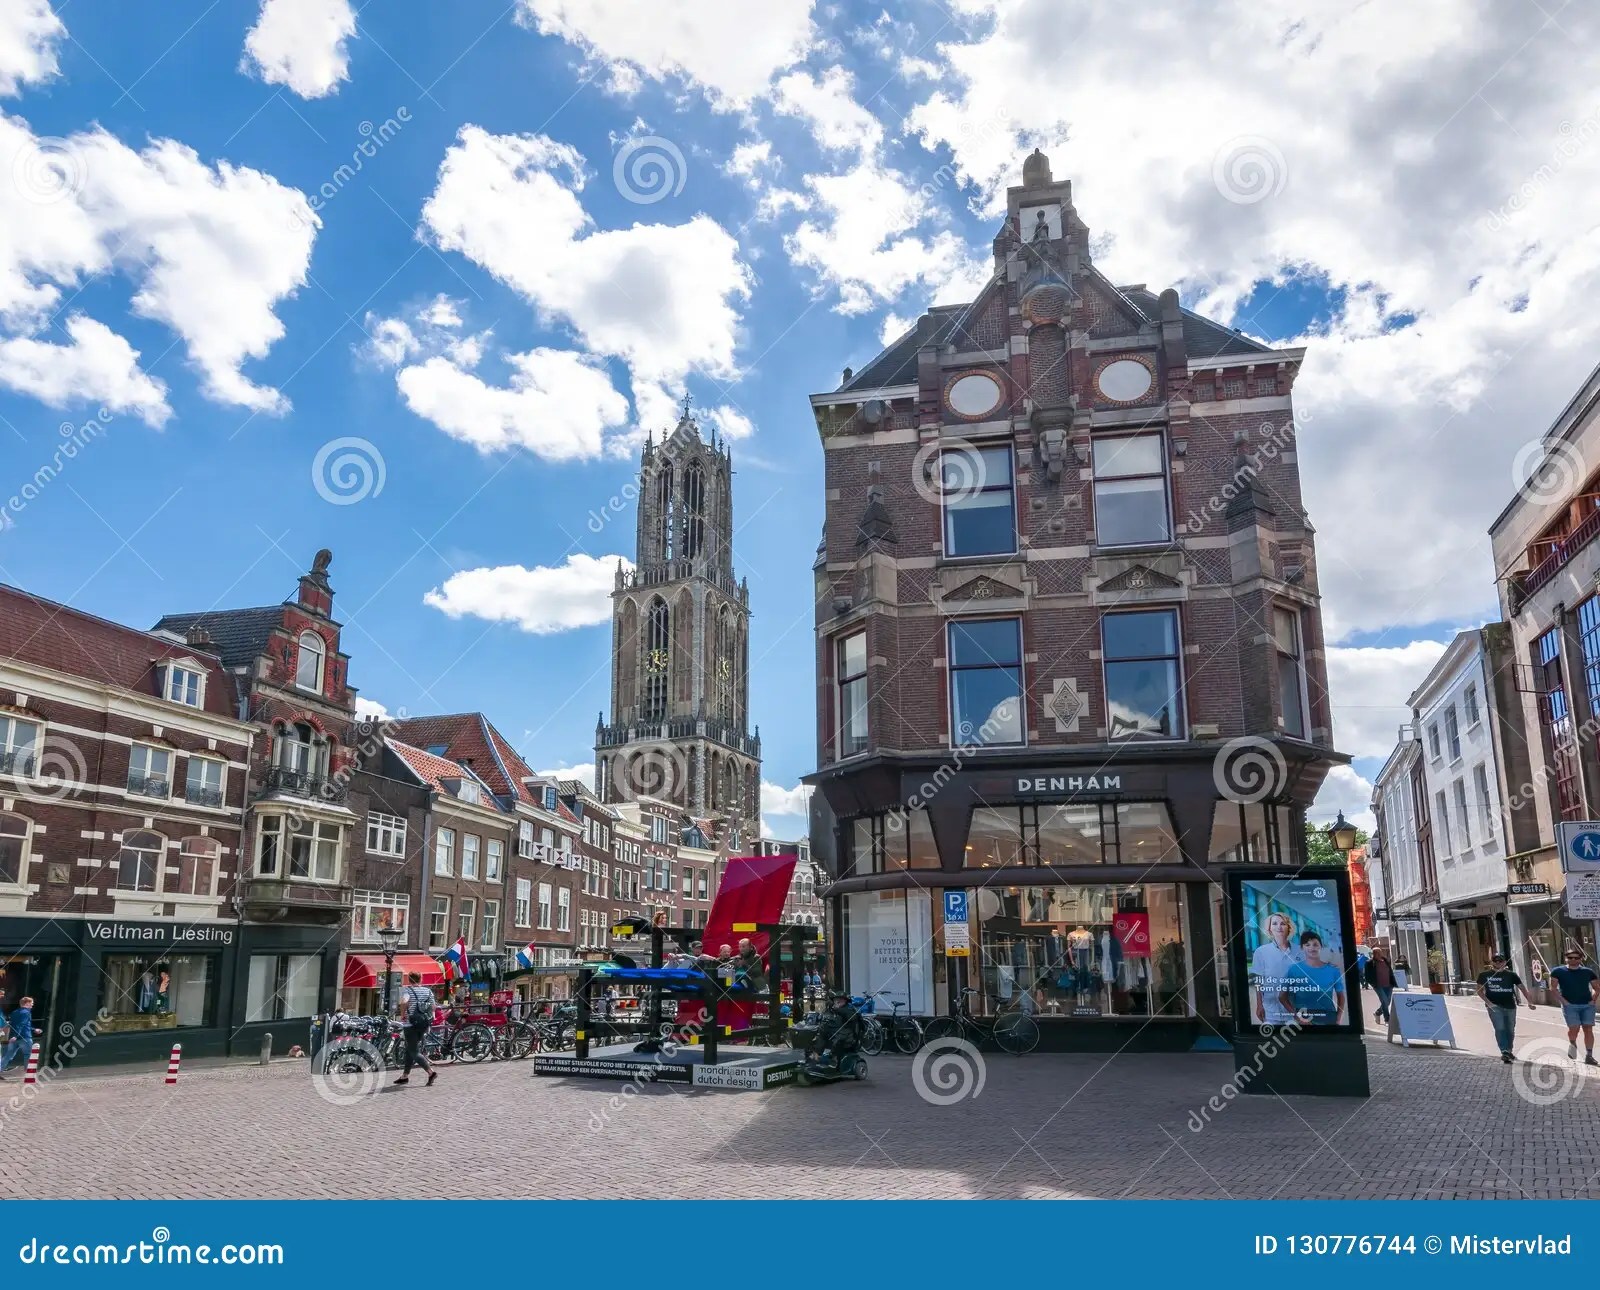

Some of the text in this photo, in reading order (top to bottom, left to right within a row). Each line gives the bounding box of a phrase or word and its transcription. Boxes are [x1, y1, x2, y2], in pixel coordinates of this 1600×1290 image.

[1018, 776, 1120, 792] DENHAM
[950, 894, 961, 910] P
[87, 922, 232, 944] Veltman Liesting
[1289, 985, 1320, 993] special
[748, 1068, 758, 1076] to
[698, 1075, 723, 1084] dutch
[727, 1077, 758, 1088] design
